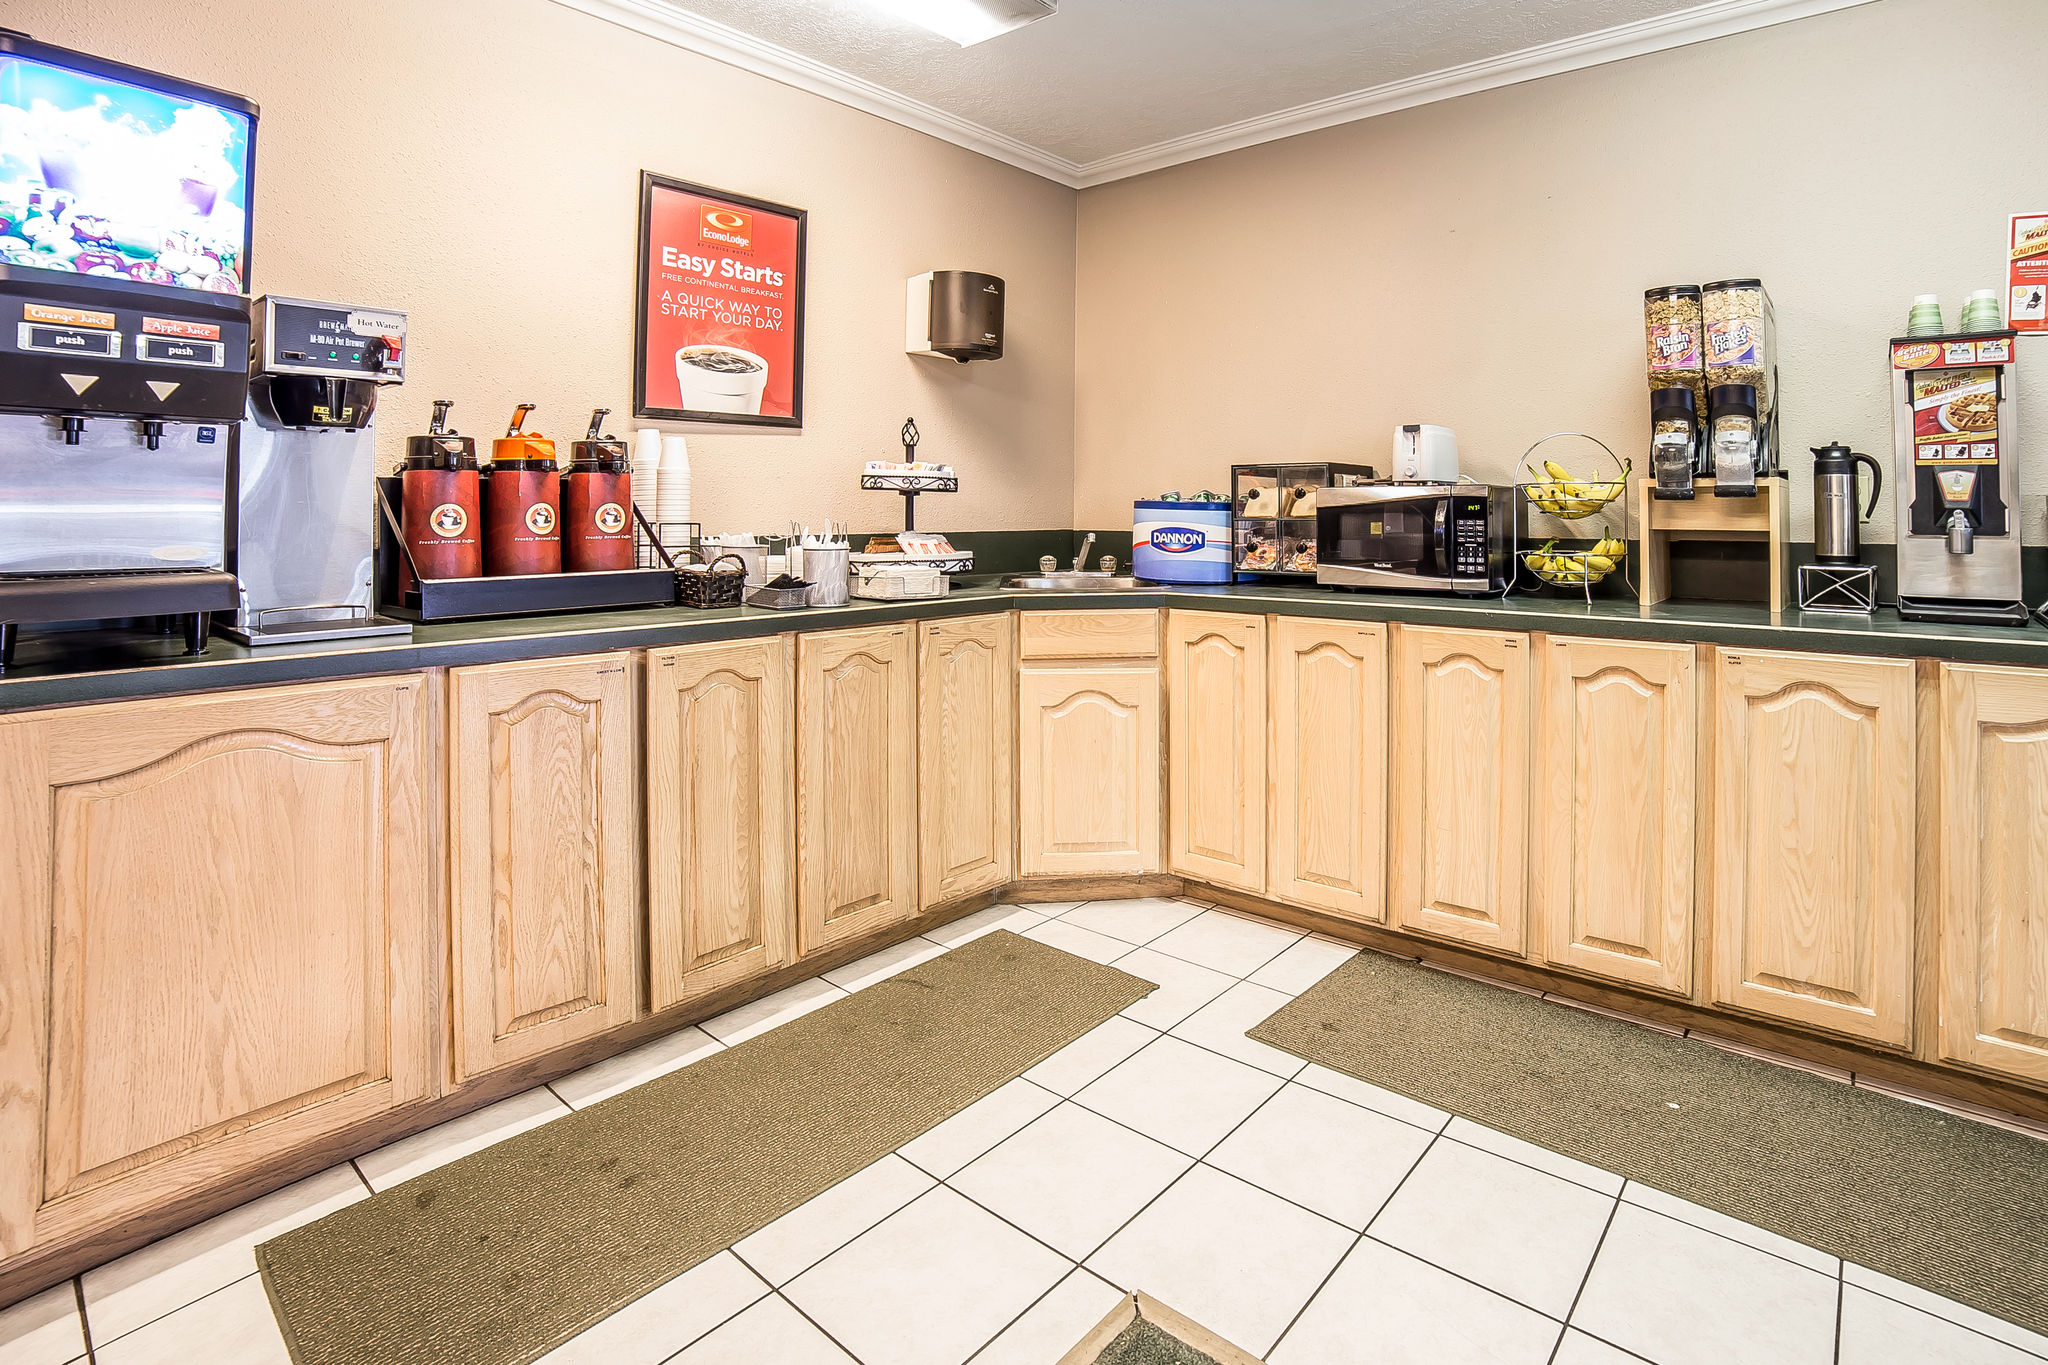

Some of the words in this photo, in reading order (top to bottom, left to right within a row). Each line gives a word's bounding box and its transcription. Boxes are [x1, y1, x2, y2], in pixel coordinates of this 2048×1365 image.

[703, 227, 750, 247] EconoLodge
[662, 245, 716, 278] Easy
[720, 257, 784, 287] Starts
[661, 272, 682, 283] FREE
[684, 276, 739, 292] CONTINENTAL
[740, 286, 785, 300] BREAKFAST.
[661, 290, 673, 302] A
[677, 292, 724, 311] QUICK
[729, 300, 760, 316] WAY
[764, 306, 783, 319] TO
[30, 308, 76, 323] Orange
[80, 312, 108, 326] Juice
[357, 318, 373, 328] Hot
[375, 320, 400, 331] Water
[661, 303, 708, 320] START
[712, 310, 752, 328] YOUR
[755, 317, 784, 332] DAY.
[152, 321, 183, 334] Apple
[186, 325, 211, 337] Juice
[1711, 325, 1748, 346] Frosted
[55, 335, 86, 346] push
[345, 338, 366, 348] Brewer
[1656, 331, 1690, 349] Raisin
[1663, 340, 1688, 357] Bran
[1715, 337, 1748, 355] Flakes
[168, 346, 194, 356] push
[1923, 381, 1961, 396] MALTED
[1153, 532, 1203, 545] DANNON
